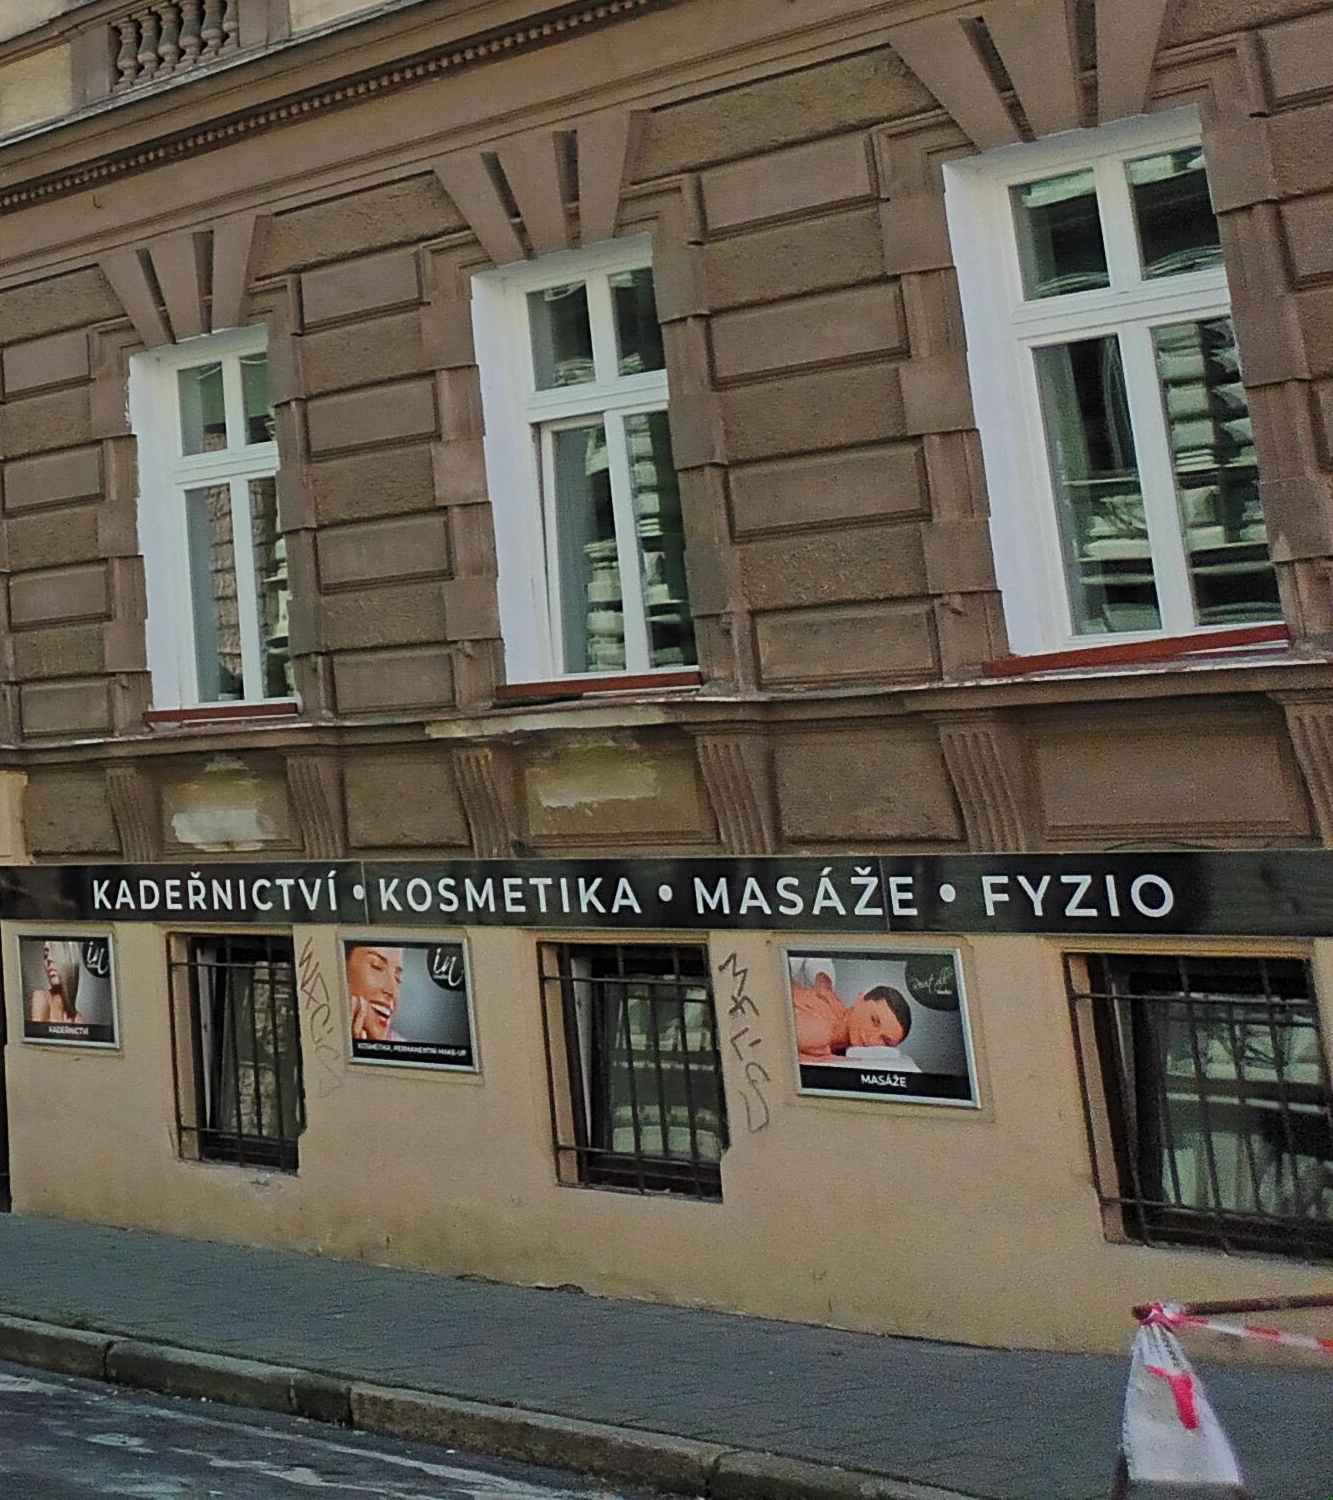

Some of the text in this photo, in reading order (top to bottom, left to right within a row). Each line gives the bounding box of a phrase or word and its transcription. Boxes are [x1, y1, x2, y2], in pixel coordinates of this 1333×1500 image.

[93, 866, 1175, 918] KADEŘNICTVÍ KOSMETIKA MASÁŽE FYZIO
[860, 1073, 907, 1088] MASÁŽE
